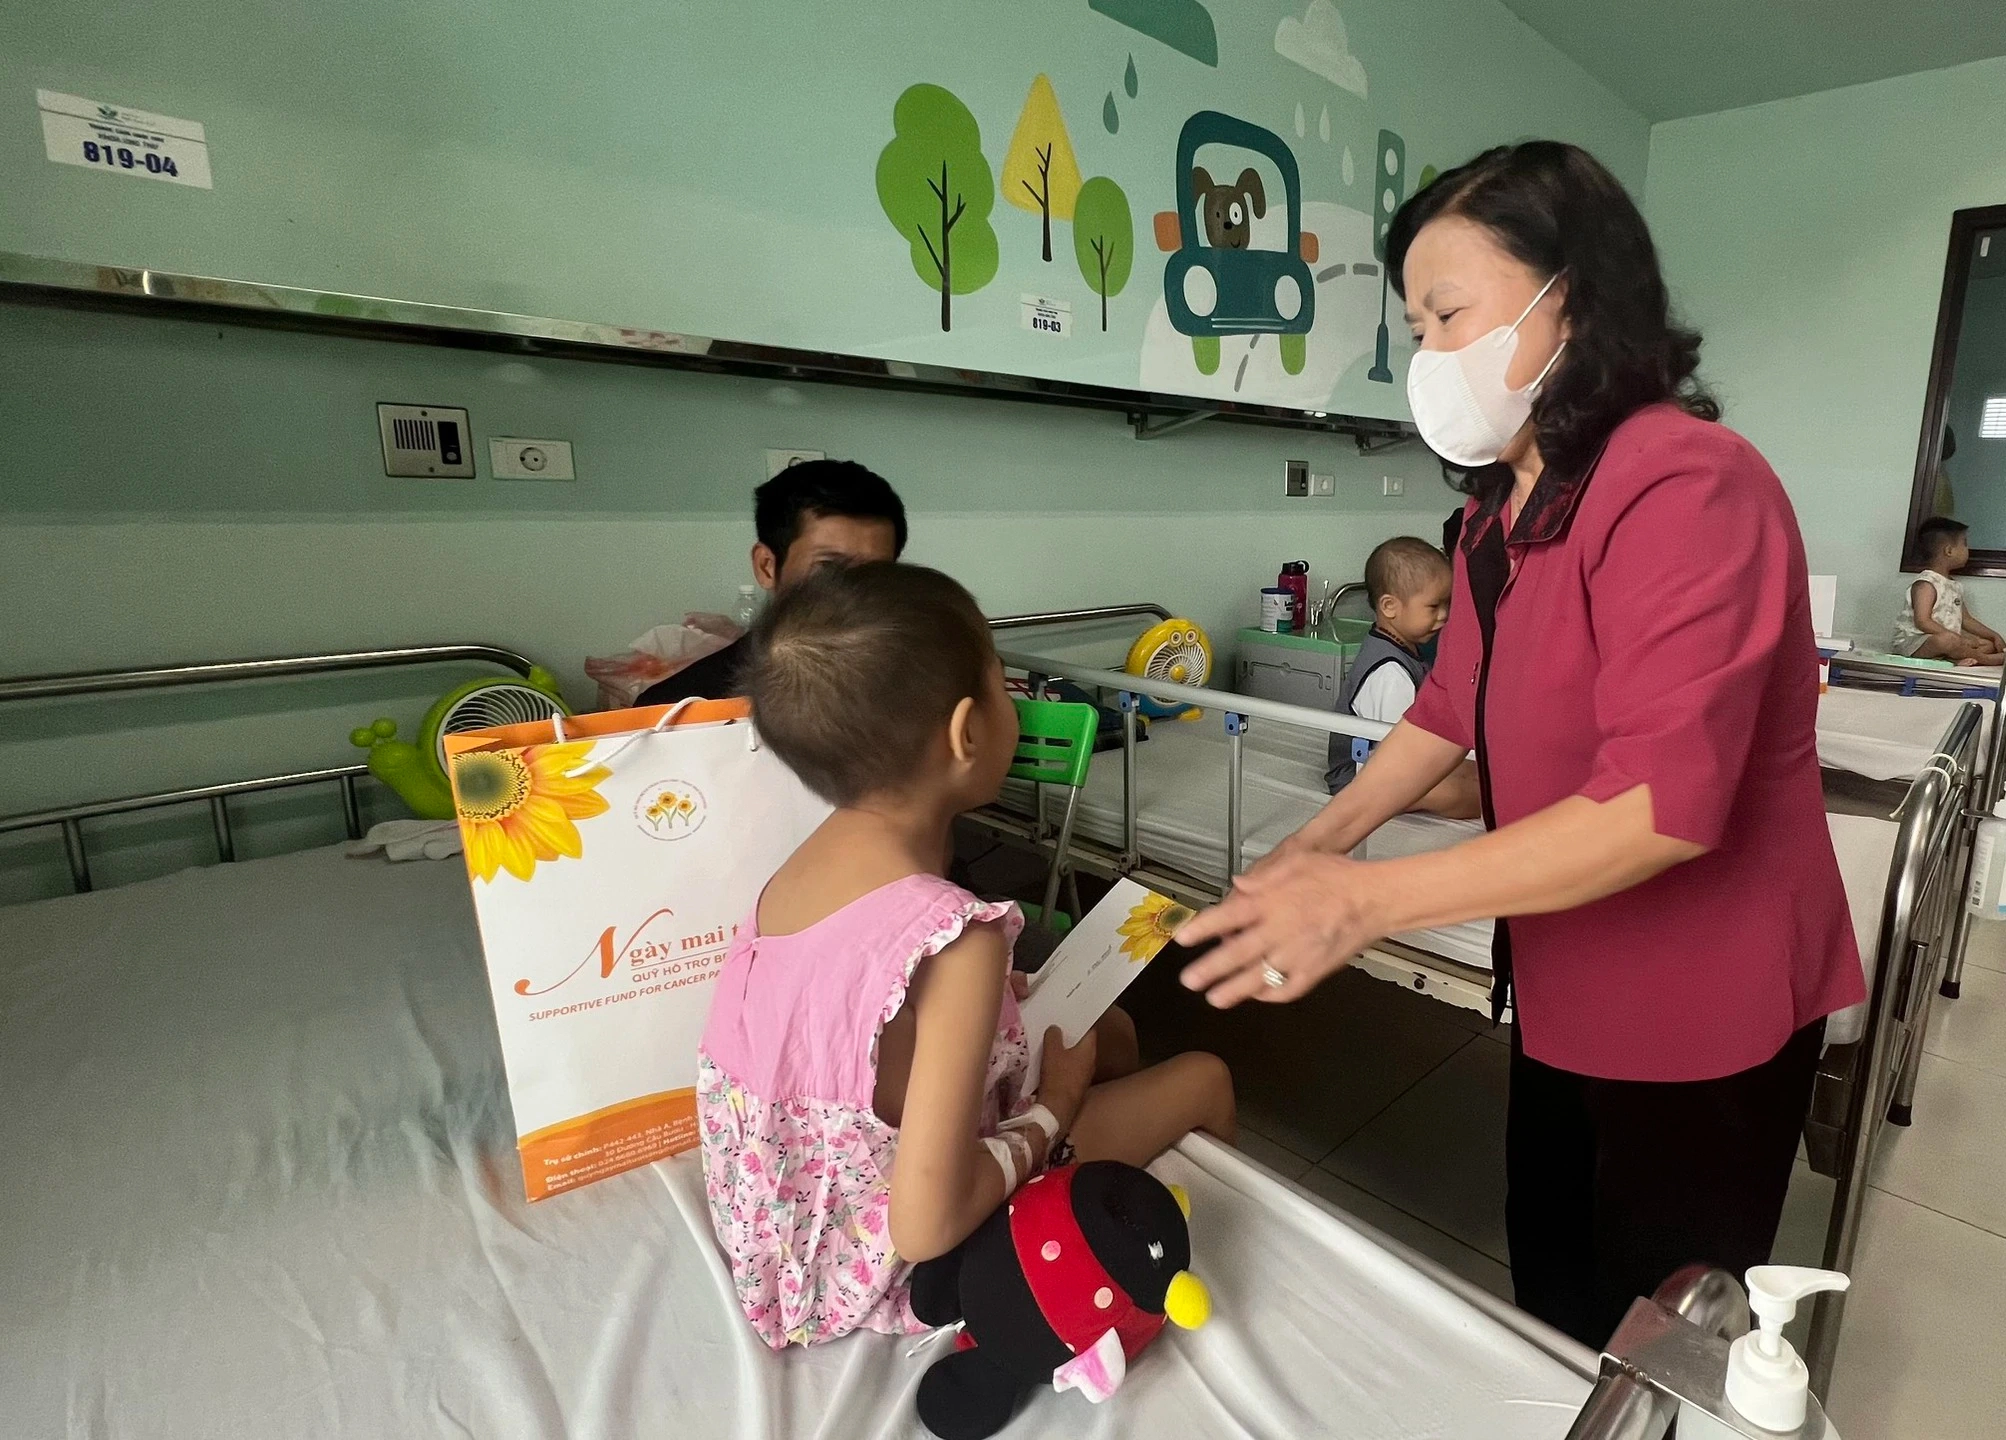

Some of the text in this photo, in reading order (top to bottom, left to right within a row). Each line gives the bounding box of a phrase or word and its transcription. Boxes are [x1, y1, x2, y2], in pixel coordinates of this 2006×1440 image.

[83, 140, 179, 177] 819-04
[1033, 317, 1061, 333] 819-03
[513, 908, 674, 996] Ngày
[681, 925, 724, 950] mai
[528, 998, 603, 1022] SUPPORTIVE
[604, 990, 637, 1005] FUND
[639, 984, 662, 997] FOR
[664, 973, 706, 990] CANCER
